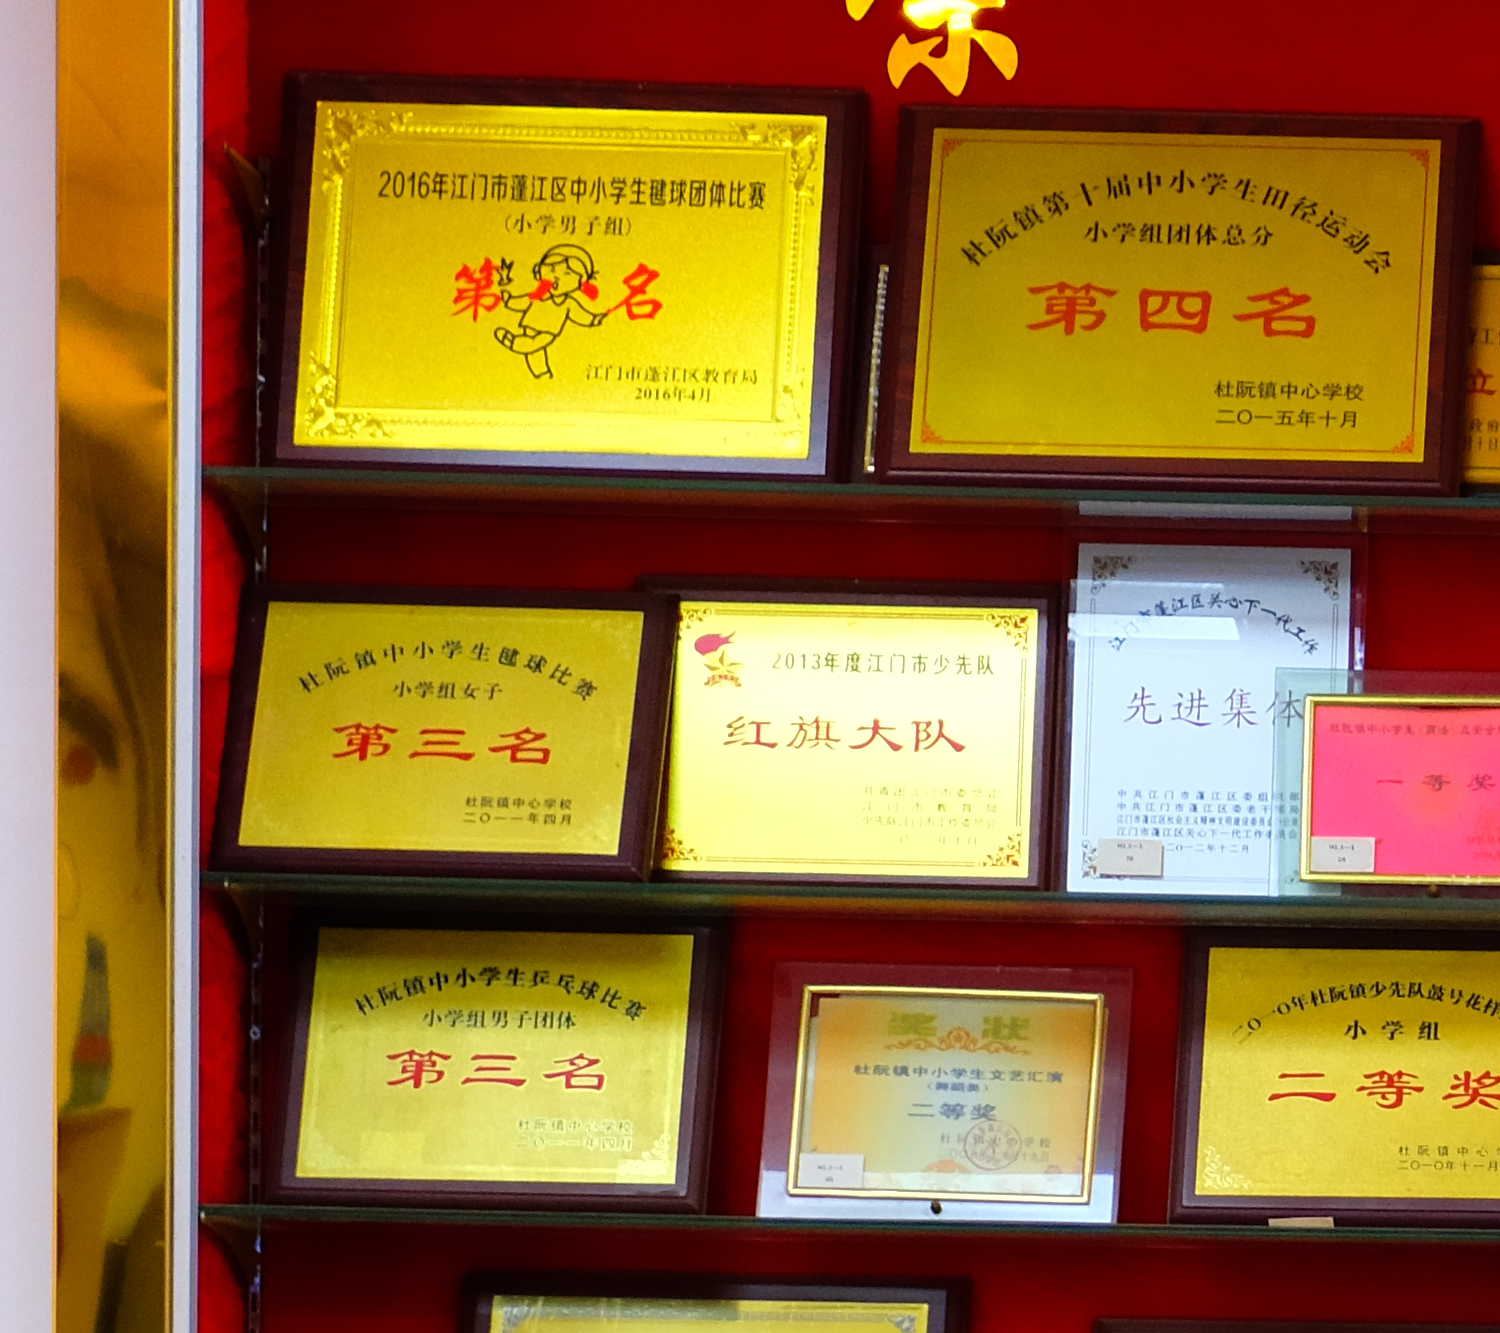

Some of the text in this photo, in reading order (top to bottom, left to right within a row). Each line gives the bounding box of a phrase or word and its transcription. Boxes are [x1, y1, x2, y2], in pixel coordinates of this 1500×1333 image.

[379, 171, 766, 210] 2016年江门市蓬江区中小学生毽球团体比赛
[959, 169, 1391, 275] 杜阮镇第十届中小学生田径运动会
[1083, 222, 1274, 248] 小学组团体总分
[1026, 282, 1317, 338] 第四名
[585, 365, 759, 387] 江门市蓬江区教育局
[634, 388, 711, 403] 2016年4月
[1214, 380, 1365, 403] 杜阮镇中心学校
[297, 639, 599, 701] 杜阮镇中小学生毽球比赛
[771, 652, 995, 676] 2013年度江门市少先队
[393, 680, 503, 701] 小学组女子
[1123, 687, 1305, 729] 先进集体
[332, 721, 551, 765] 第三名
[723, 715, 966, 753] 红旗大队
[1376, 774, 1496, 792] 一等奖
[465, 795, 572, 811] 杜阮镇中心学校
[353, 965, 648, 1023] 杜阮镇中小学生乒乓球比赛
[422, 1008, 577, 1031] 小学组男子团体
[887, 1011, 1033, 1041] 奖状
[1344, 1020, 1440, 1041] 小学组
[386, 1049, 605, 1091] 第三名
[853, 1064, 1063, 1084] 杜阮镇中小学生文艺汇演
[907, 1102, 997, 1122] 二等奖
